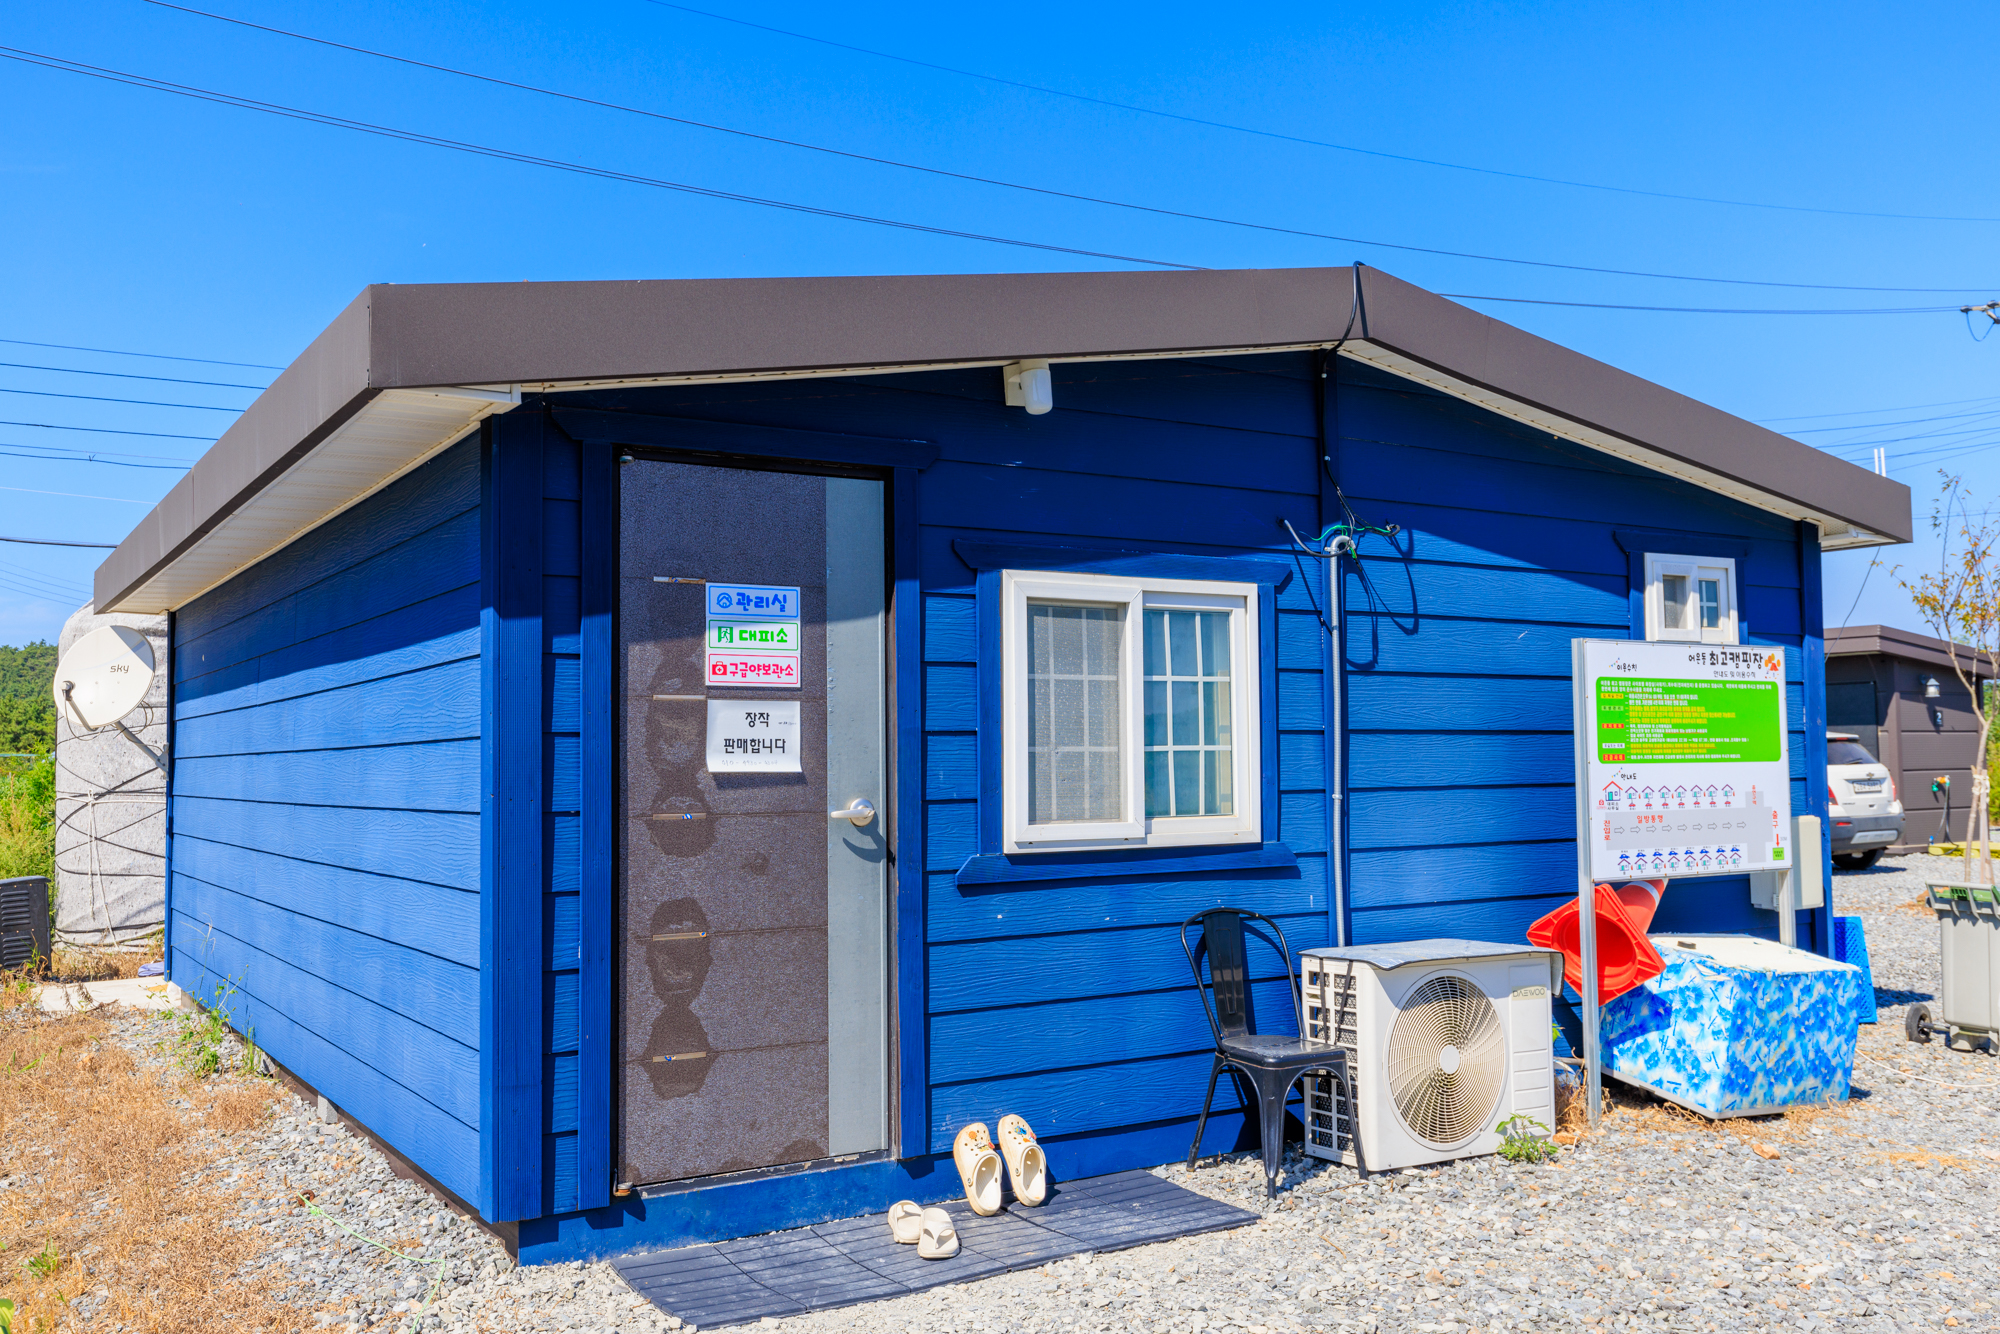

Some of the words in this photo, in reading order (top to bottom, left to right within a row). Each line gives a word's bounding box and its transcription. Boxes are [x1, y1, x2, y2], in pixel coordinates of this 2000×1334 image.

[736, 592, 787, 613] 관리실
[738, 627, 788, 643] 대피소
[1709, 650, 1764, 670] 최고캠핑장
[110, 664, 130, 674] sky
[729, 662, 794, 679] 구급약보관소
[745, 711, 770, 728] 장작
[723, 737, 787, 754] 판매합니다
[1620, 773, 1637, 781] 안내도
[1636, 814, 1664, 824] 일방통행
[1512, 988, 1545, 998] DAEWOO
